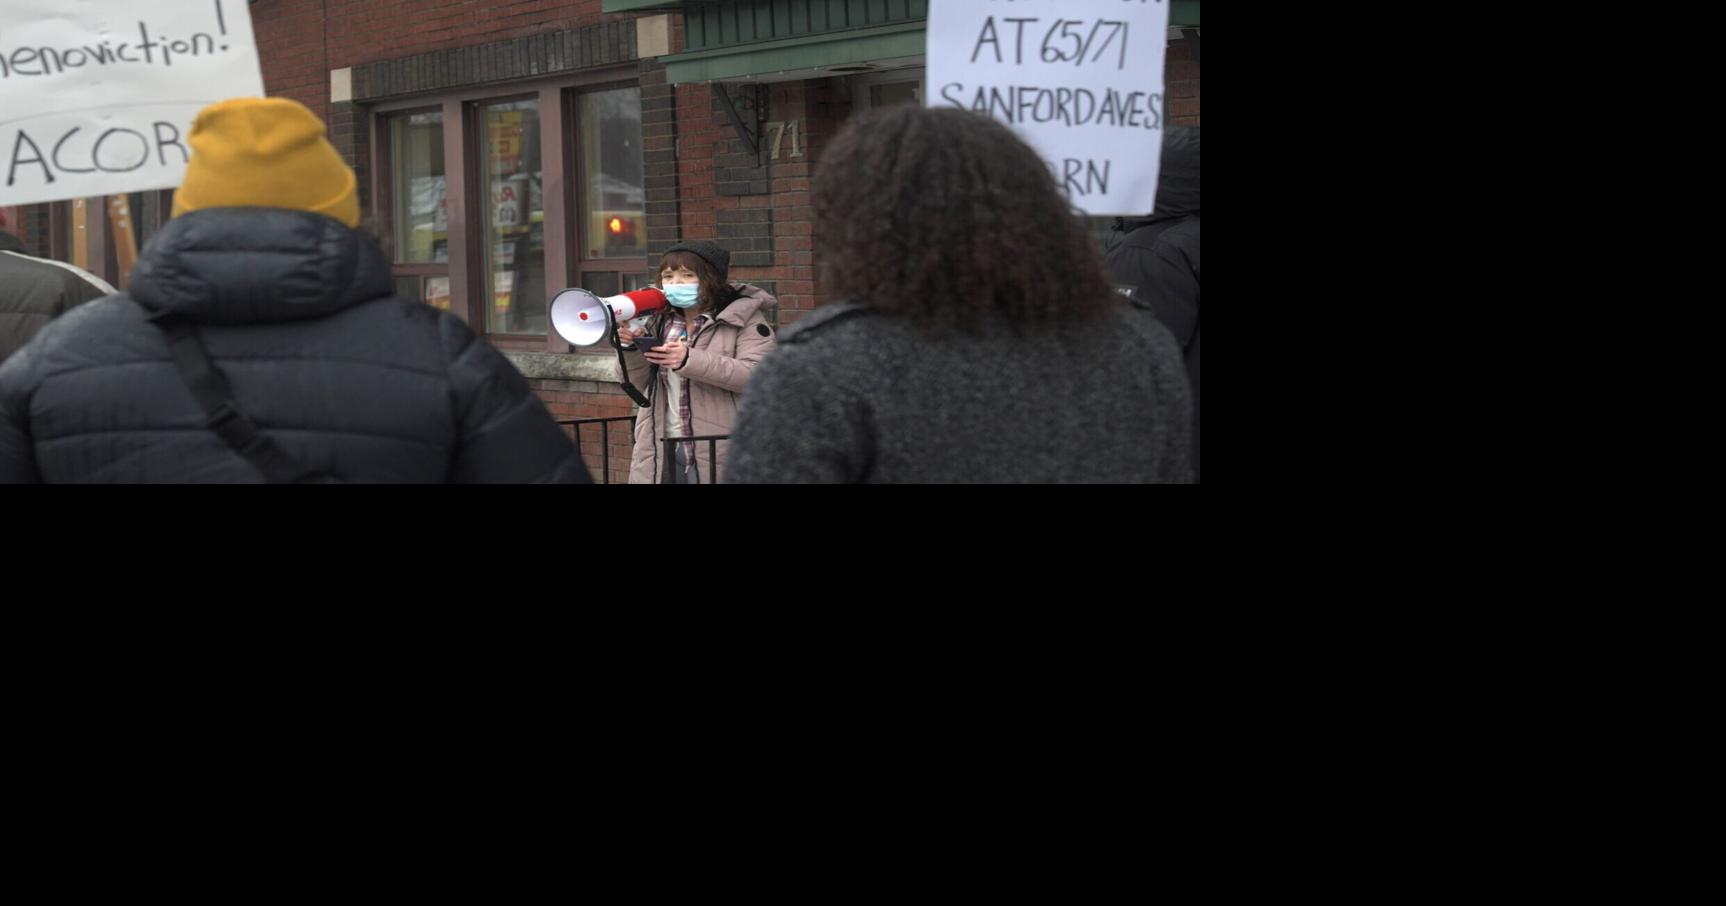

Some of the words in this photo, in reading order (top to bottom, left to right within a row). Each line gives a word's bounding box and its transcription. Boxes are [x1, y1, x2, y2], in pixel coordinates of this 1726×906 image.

[969, 15, 1039, 65] AT
[1040, 18, 1129, 70] 65/71
[766, 120, 803, 160] 71
[1047, 157, 1111, 196] RN
